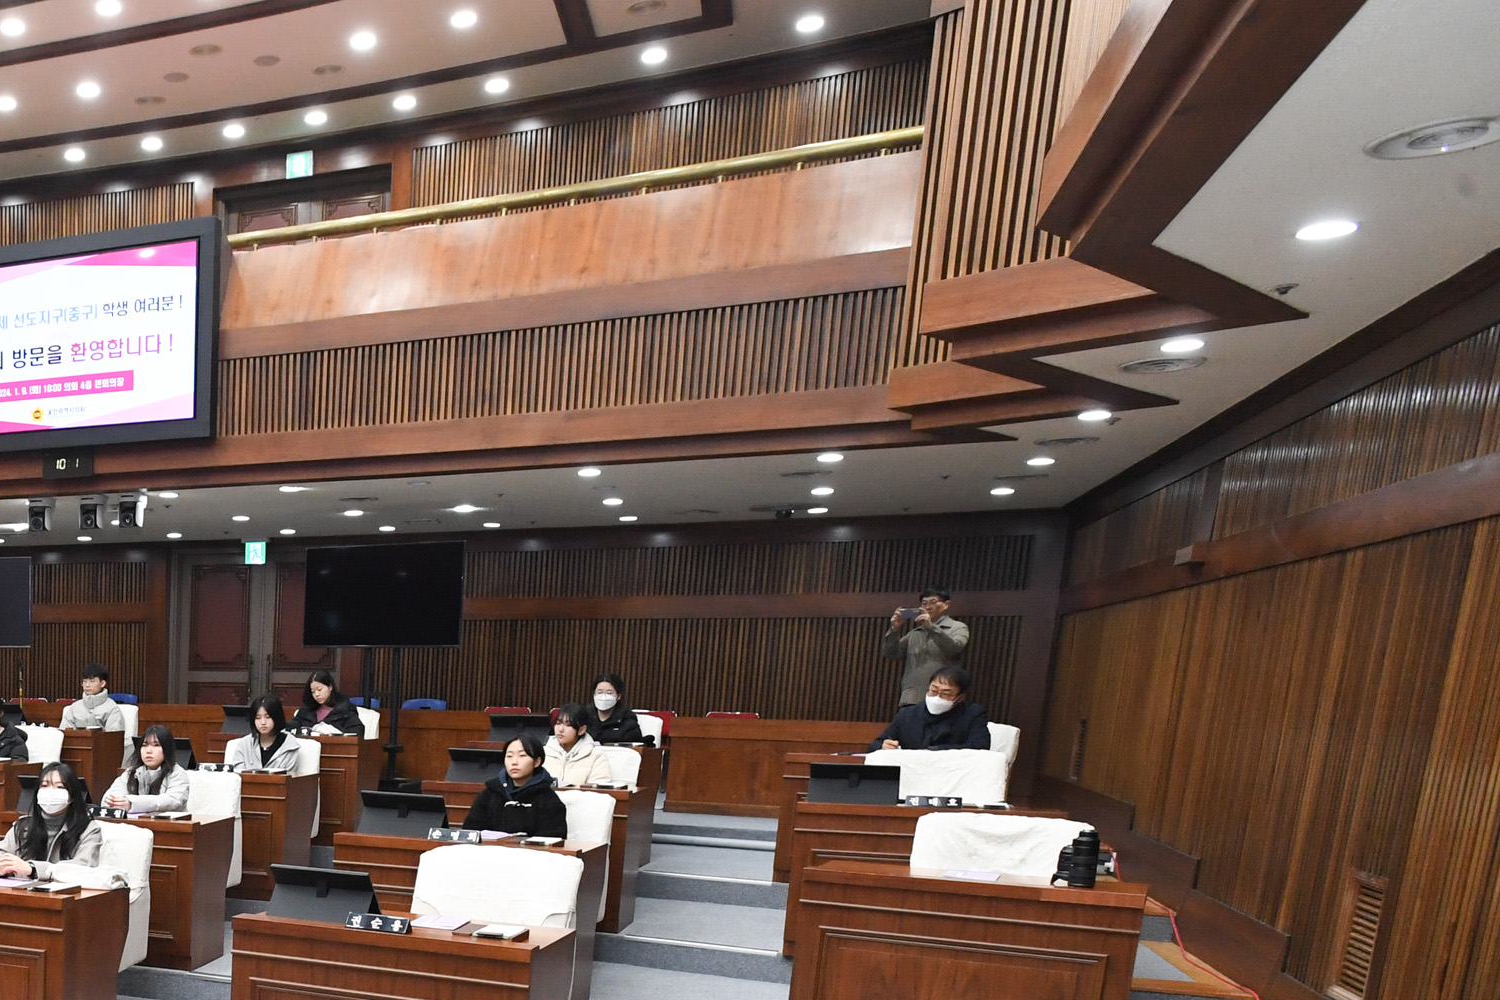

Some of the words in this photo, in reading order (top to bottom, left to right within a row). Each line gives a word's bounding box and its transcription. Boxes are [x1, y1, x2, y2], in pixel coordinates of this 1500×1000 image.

[14, 304, 98, 328] 선도지구(중구)
[102, 300, 128, 317] 학생
[134, 295, 174, 314] 여러분
[12, 344, 62, 369] 방문을
[70, 333, 161, 362] 환영합니다
